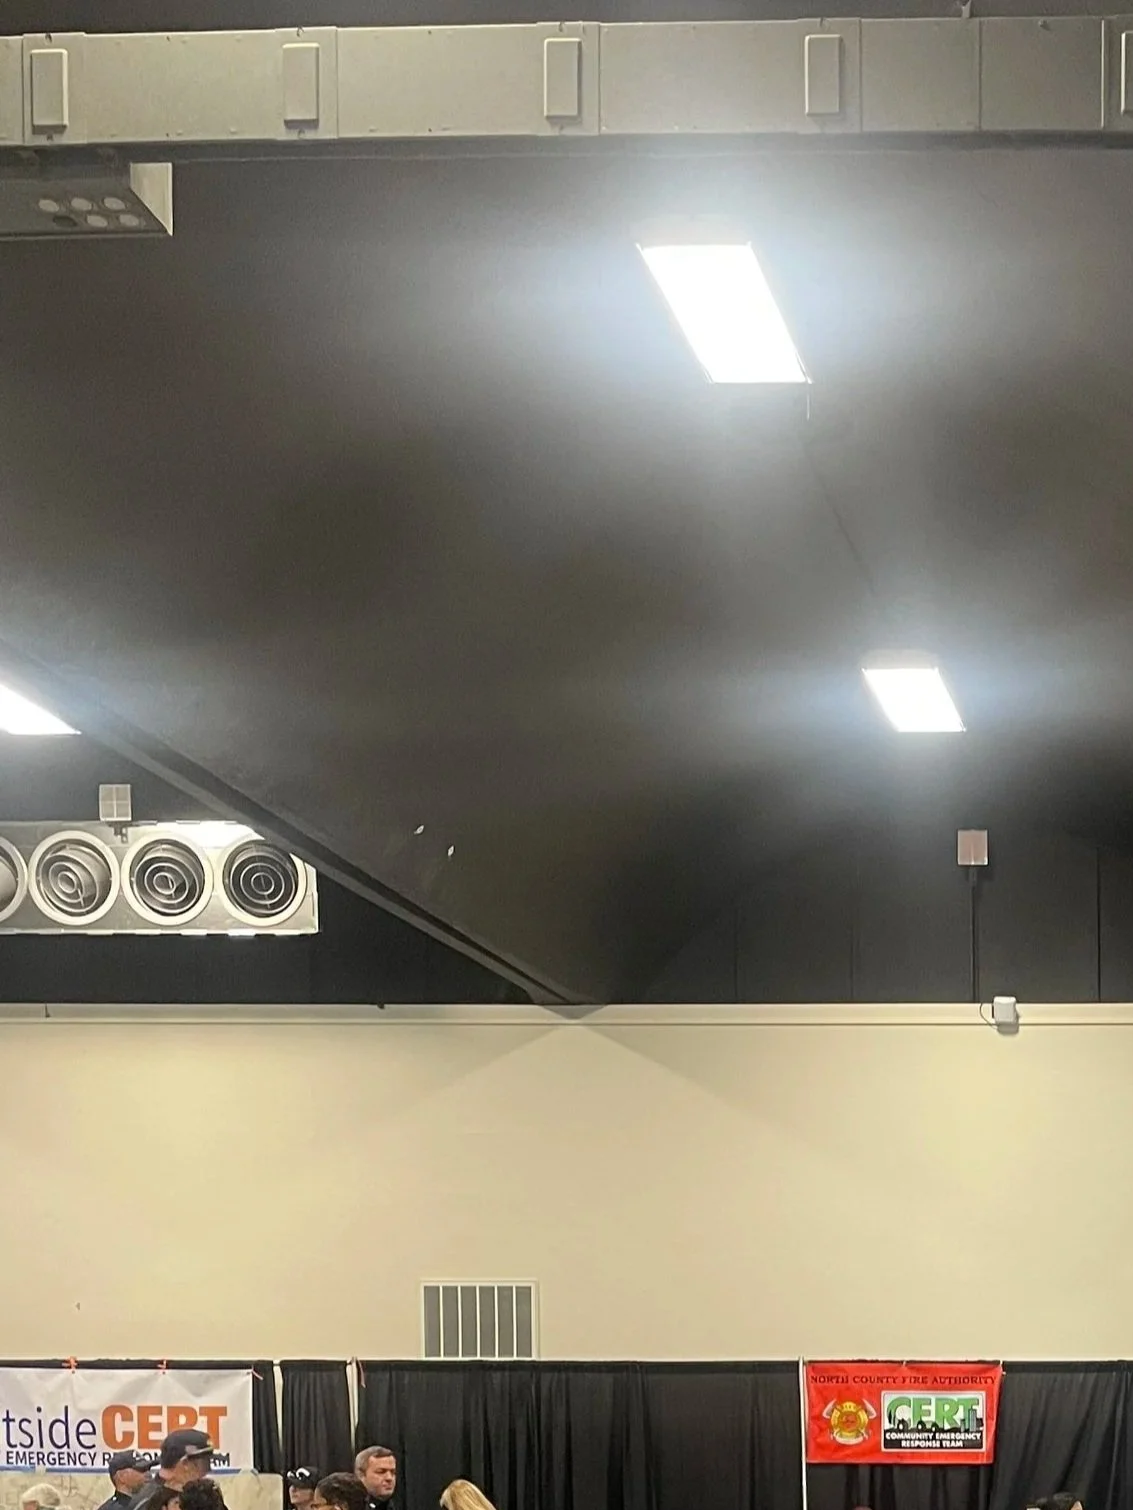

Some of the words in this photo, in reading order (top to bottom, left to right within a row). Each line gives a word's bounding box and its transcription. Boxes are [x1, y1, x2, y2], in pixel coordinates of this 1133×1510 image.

[811, 1376, 849, 1385] NORTH
[853, 1376, 897, 1385] COUNTY
[902, 1376, 928, 1384] FIRE
[932, 1376, 996, 1385] AUTHORITY
[886, 1396, 979, 1430] CERT
[885, 1432, 934, 1440] COMMUNITY
[936, 1432, 981, 1440] EMERGENCY
[901, 1440, 940, 1448] RESPONSE
[942, 1440, 963, 1448] TEAM
[6, 1452, 97, 1466] EMERGENCY
